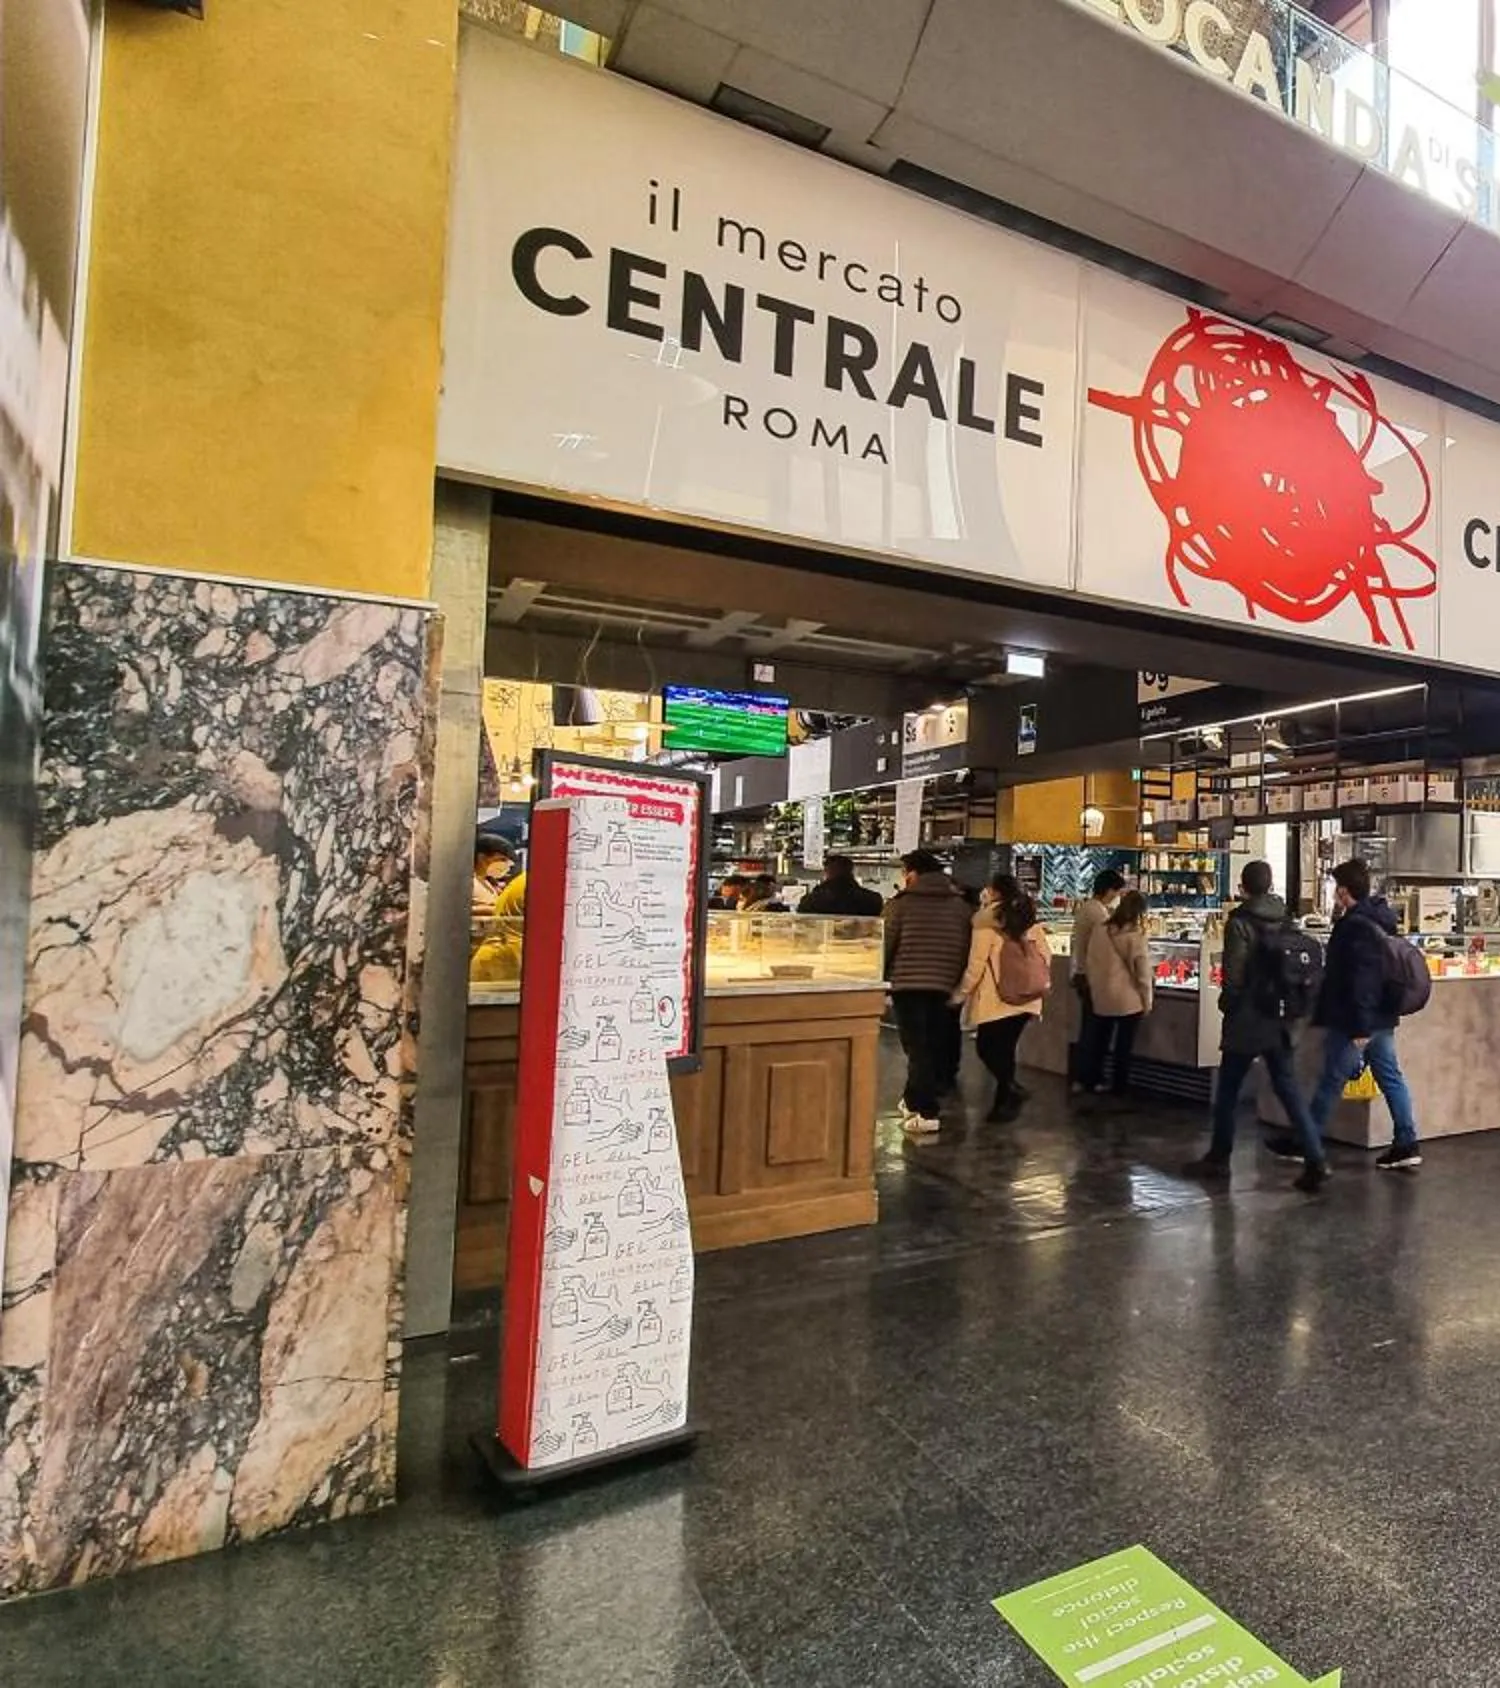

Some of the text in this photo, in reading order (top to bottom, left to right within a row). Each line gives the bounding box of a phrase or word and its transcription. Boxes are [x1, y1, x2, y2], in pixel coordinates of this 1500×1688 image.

[1081, 0, 1428, 191] OCANDA
[647, 179, 963, 324] il mercato
[511, 226, 1045, 448] CENTRALE
[722, 394, 889, 465] ROMA
[1051, 1576, 1141, 1618] distance
[1062, 1596, 1187, 1655] Respect the
[1080, 1596, 1143, 1631] social
